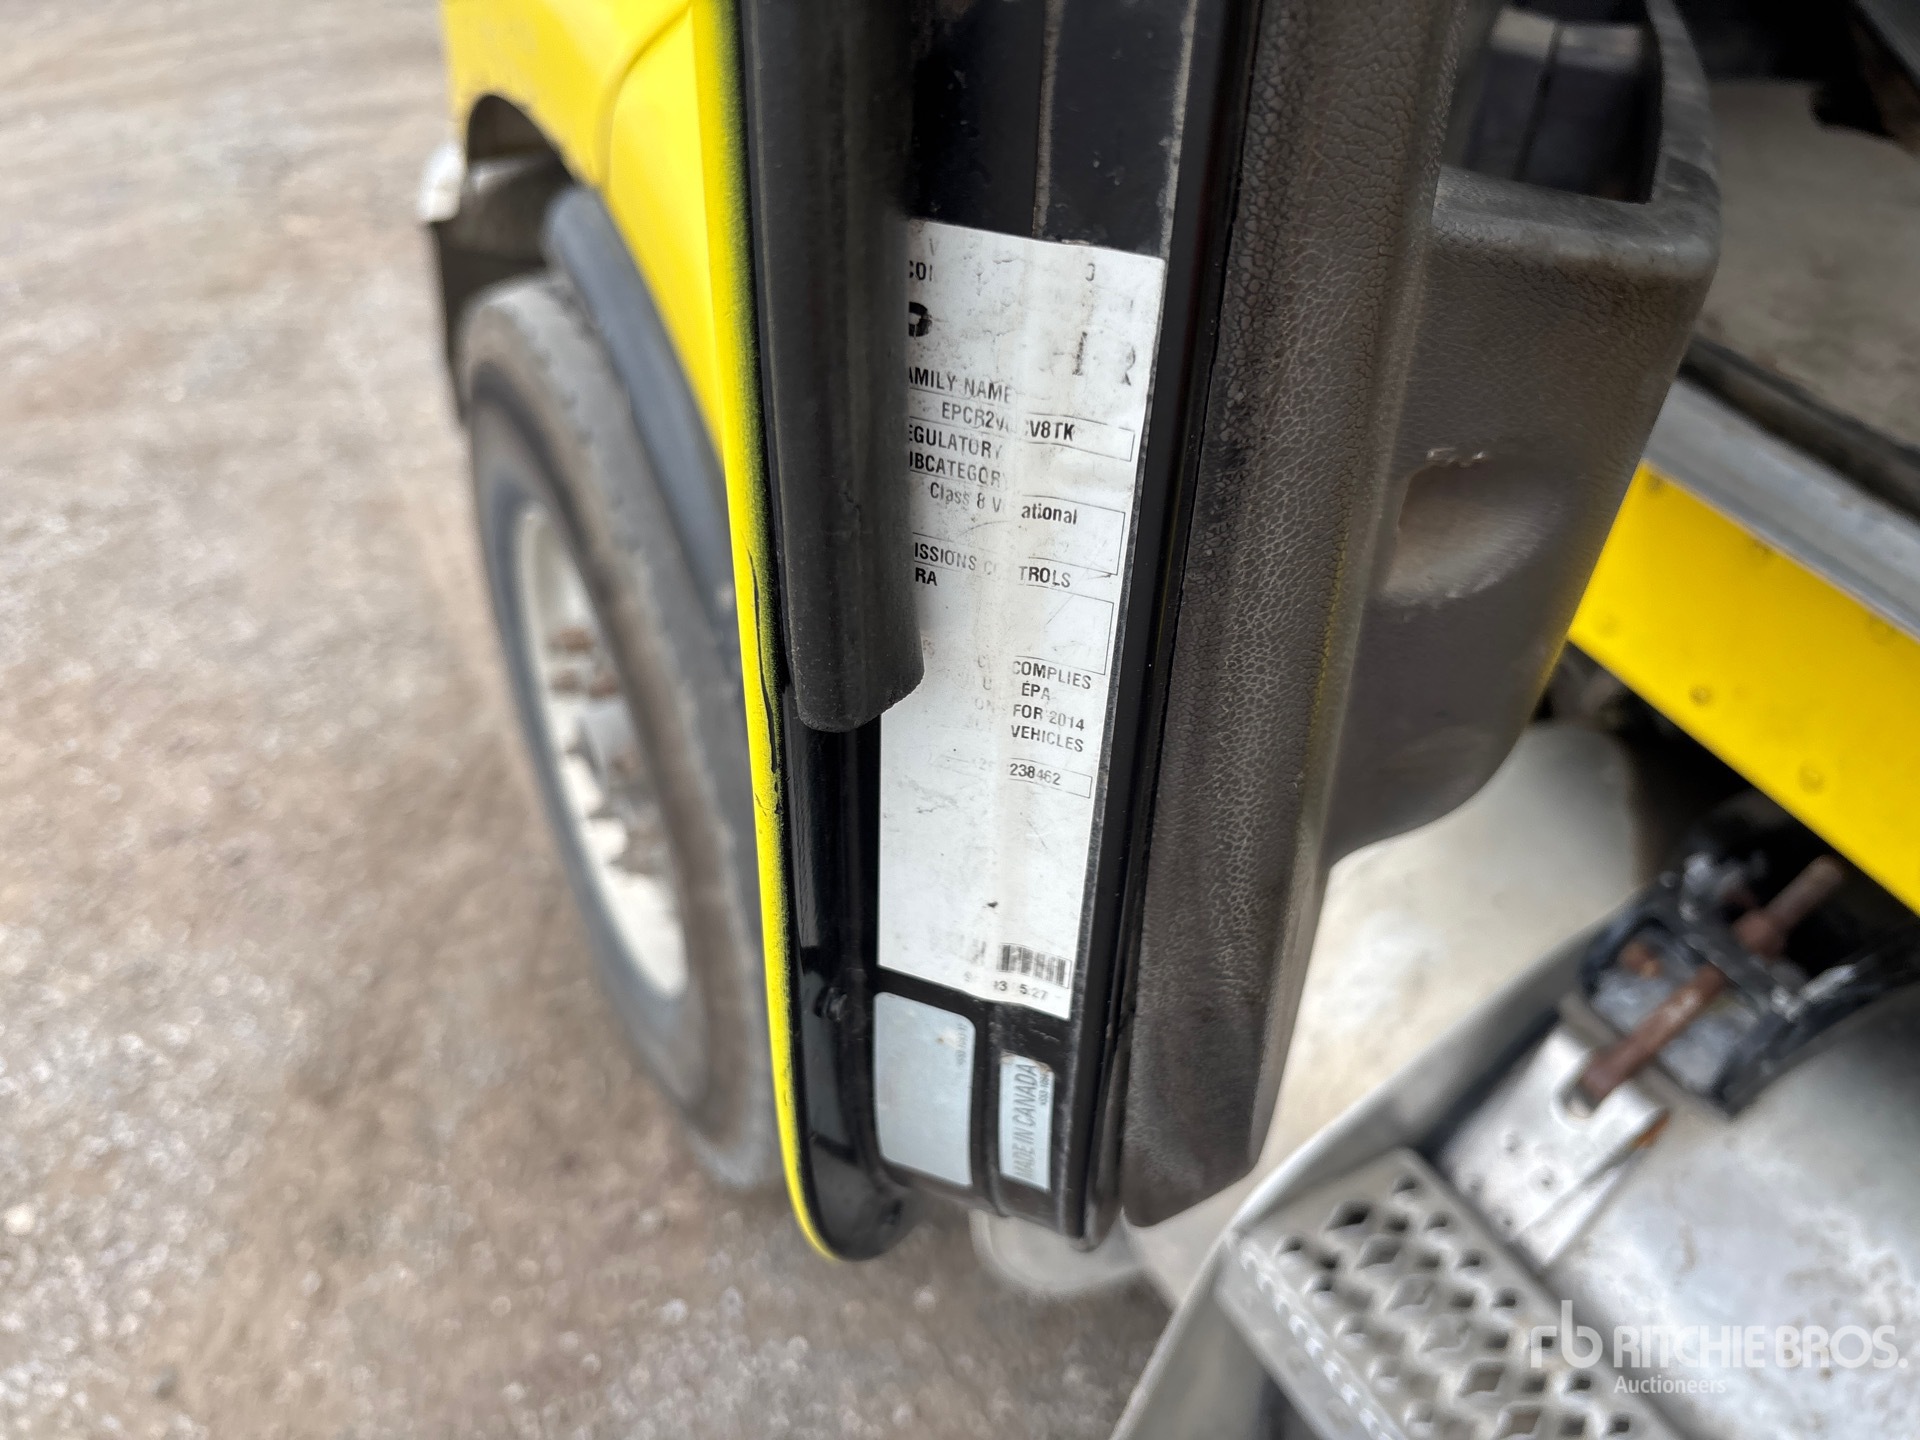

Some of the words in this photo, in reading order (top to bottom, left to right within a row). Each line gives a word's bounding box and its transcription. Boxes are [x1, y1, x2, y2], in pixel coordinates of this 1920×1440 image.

[1012, 660, 1092, 690] COMPLIES
[1021, 682, 1051, 701] EPA
[1013, 703, 1044, 721] FOR
[1048, 710, 1086, 732] 2014
[1010, 724, 1084, 753] VEHICLES
[1009, 762, 1062, 786] 238462
[1012, 1064, 1037, 1127] CANADA
[1012, 1127, 1036, 1146] IN
[1011, 1143, 1036, 1179] MADE
